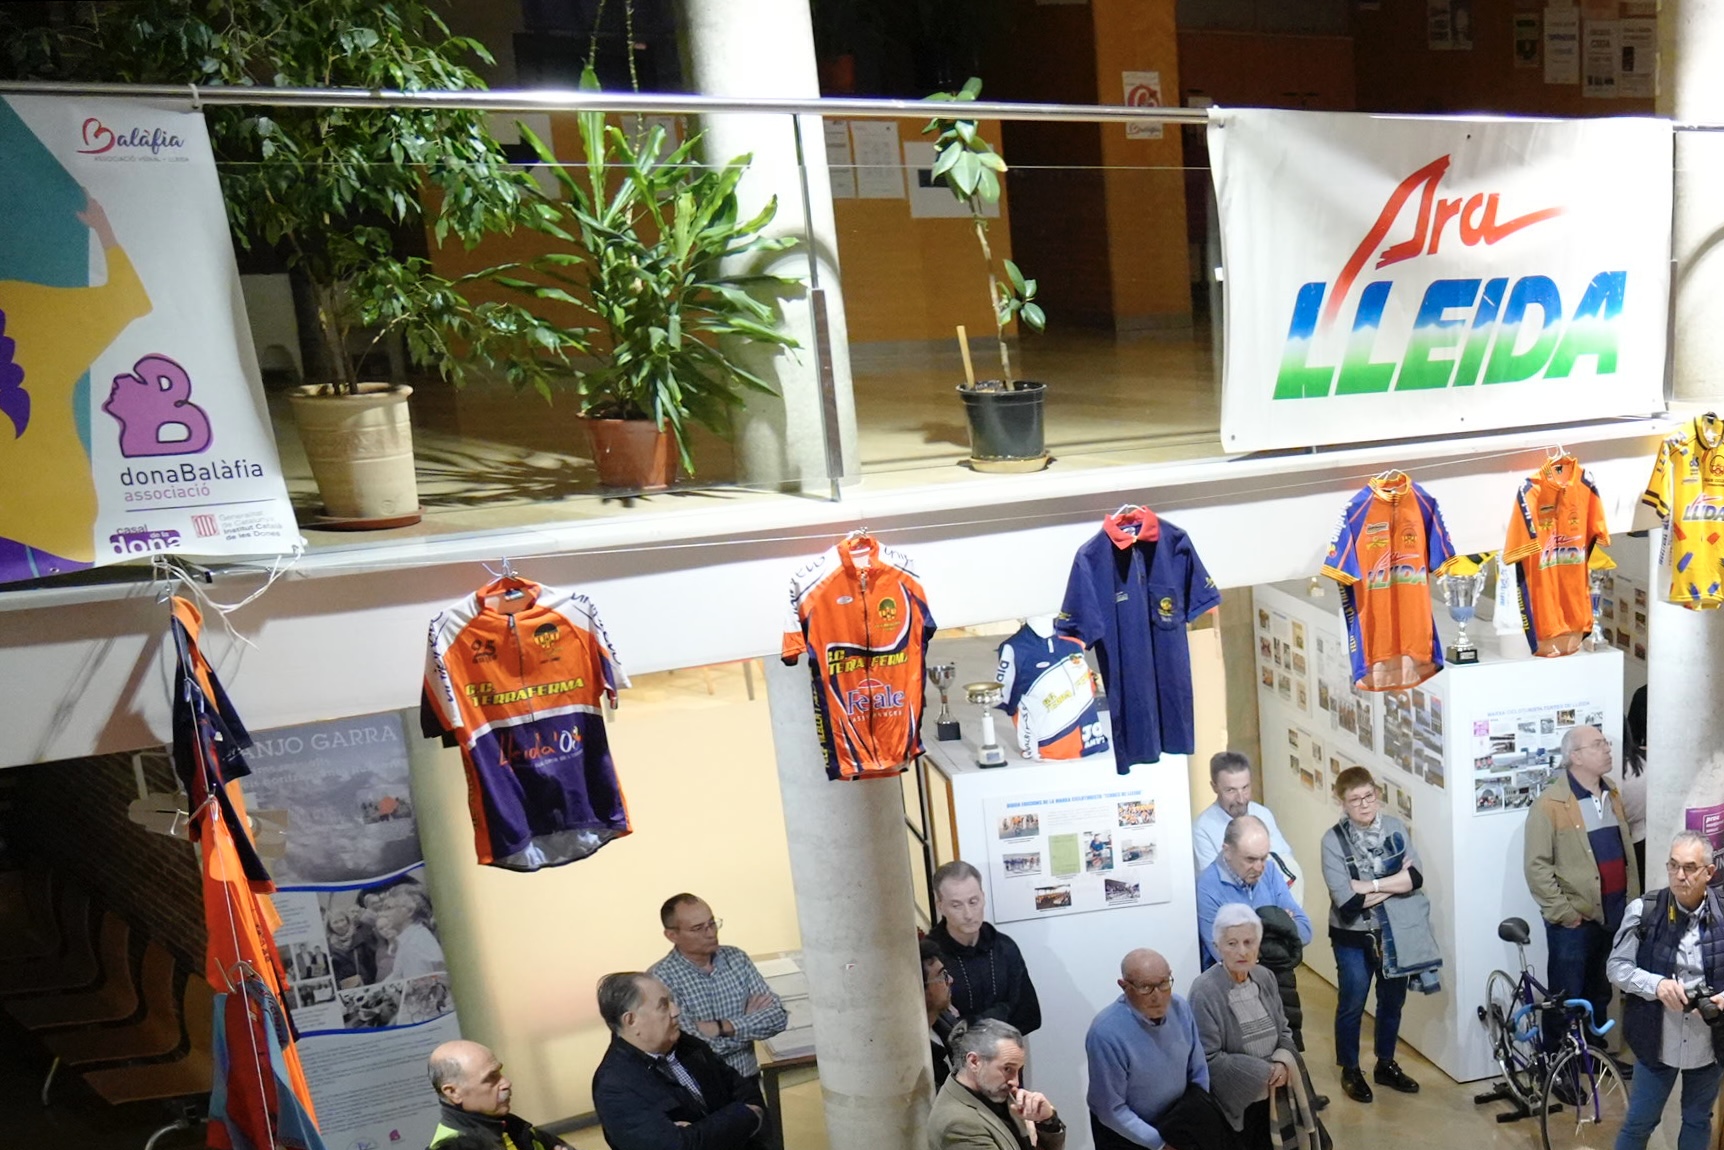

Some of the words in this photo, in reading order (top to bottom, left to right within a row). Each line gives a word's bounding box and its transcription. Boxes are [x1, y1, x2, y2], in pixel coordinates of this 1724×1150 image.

[1272, 270, 1627, 400] LLEIDA
[120, 461, 264, 486] donaBalàfia
[124, 484, 210, 502] associació
[472, 678, 584, 707] TERRAFERMA
[311, 726, 397, 751] GARRA
